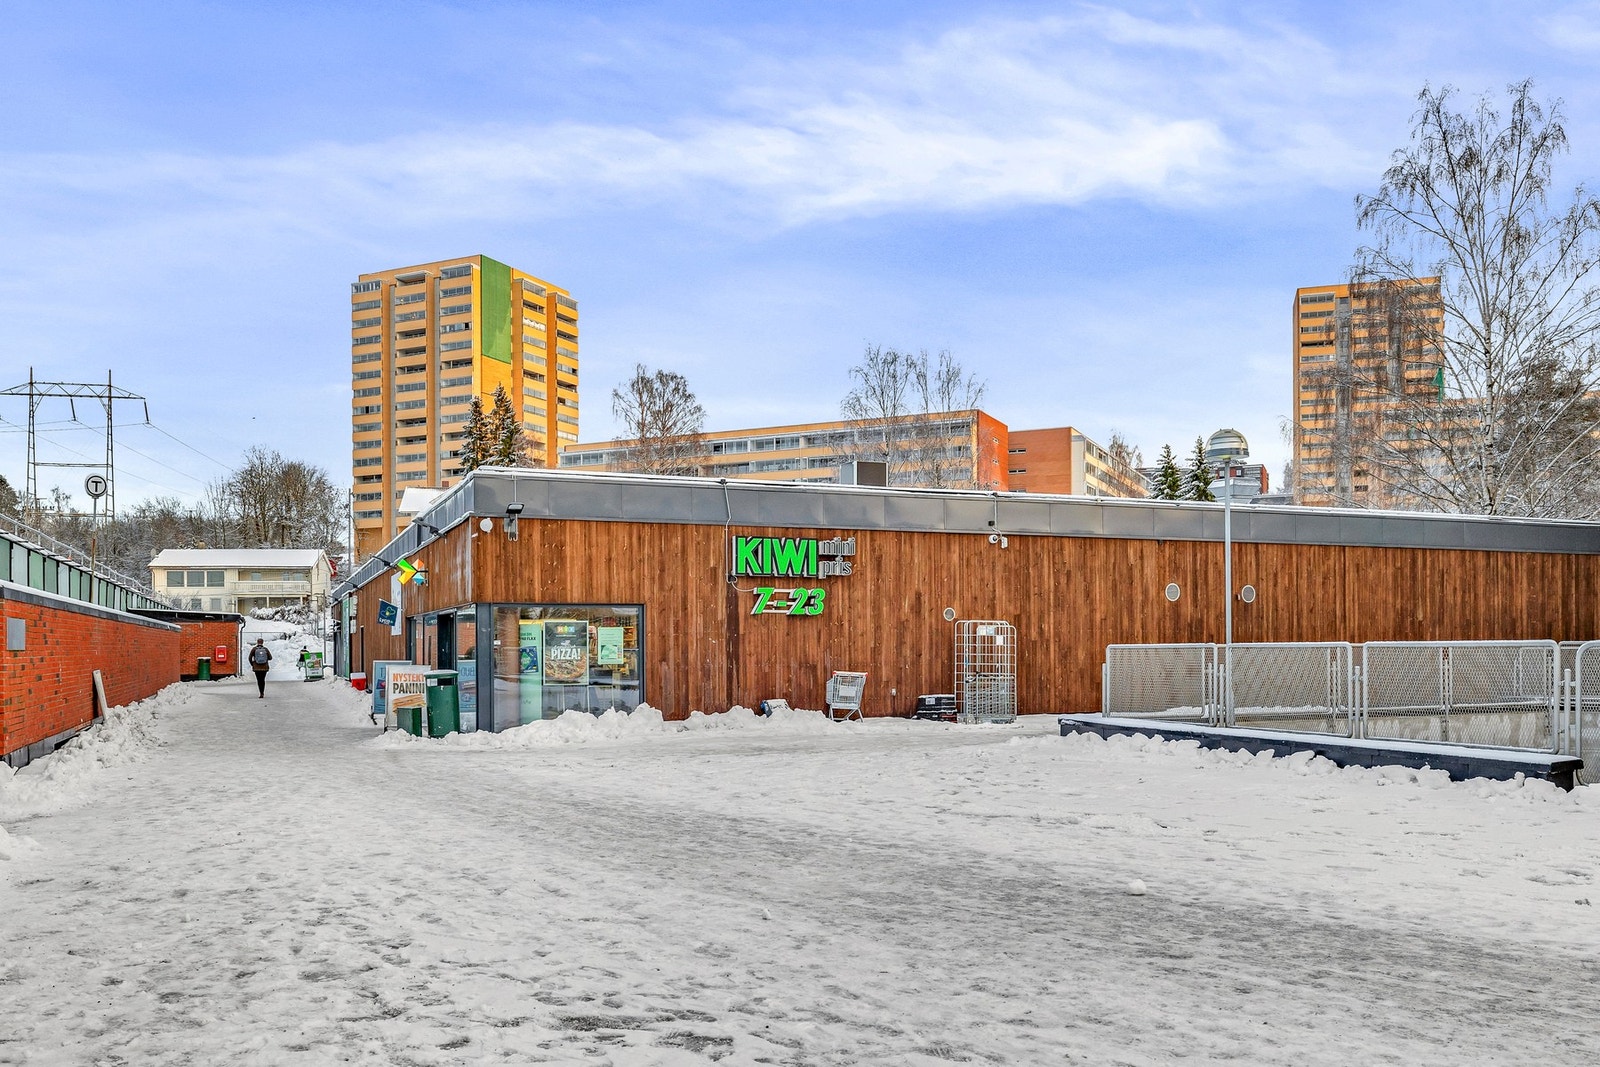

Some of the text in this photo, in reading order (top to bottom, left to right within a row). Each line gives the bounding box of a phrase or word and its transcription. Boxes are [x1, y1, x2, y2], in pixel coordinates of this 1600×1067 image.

[821, 537, 855, 555] mini
[735, 536, 818, 576] KIWI
[821, 556, 852, 578] pris
[550, 648, 581, 660] PIZZA!
[392, 682, 425, 695] PANINI
